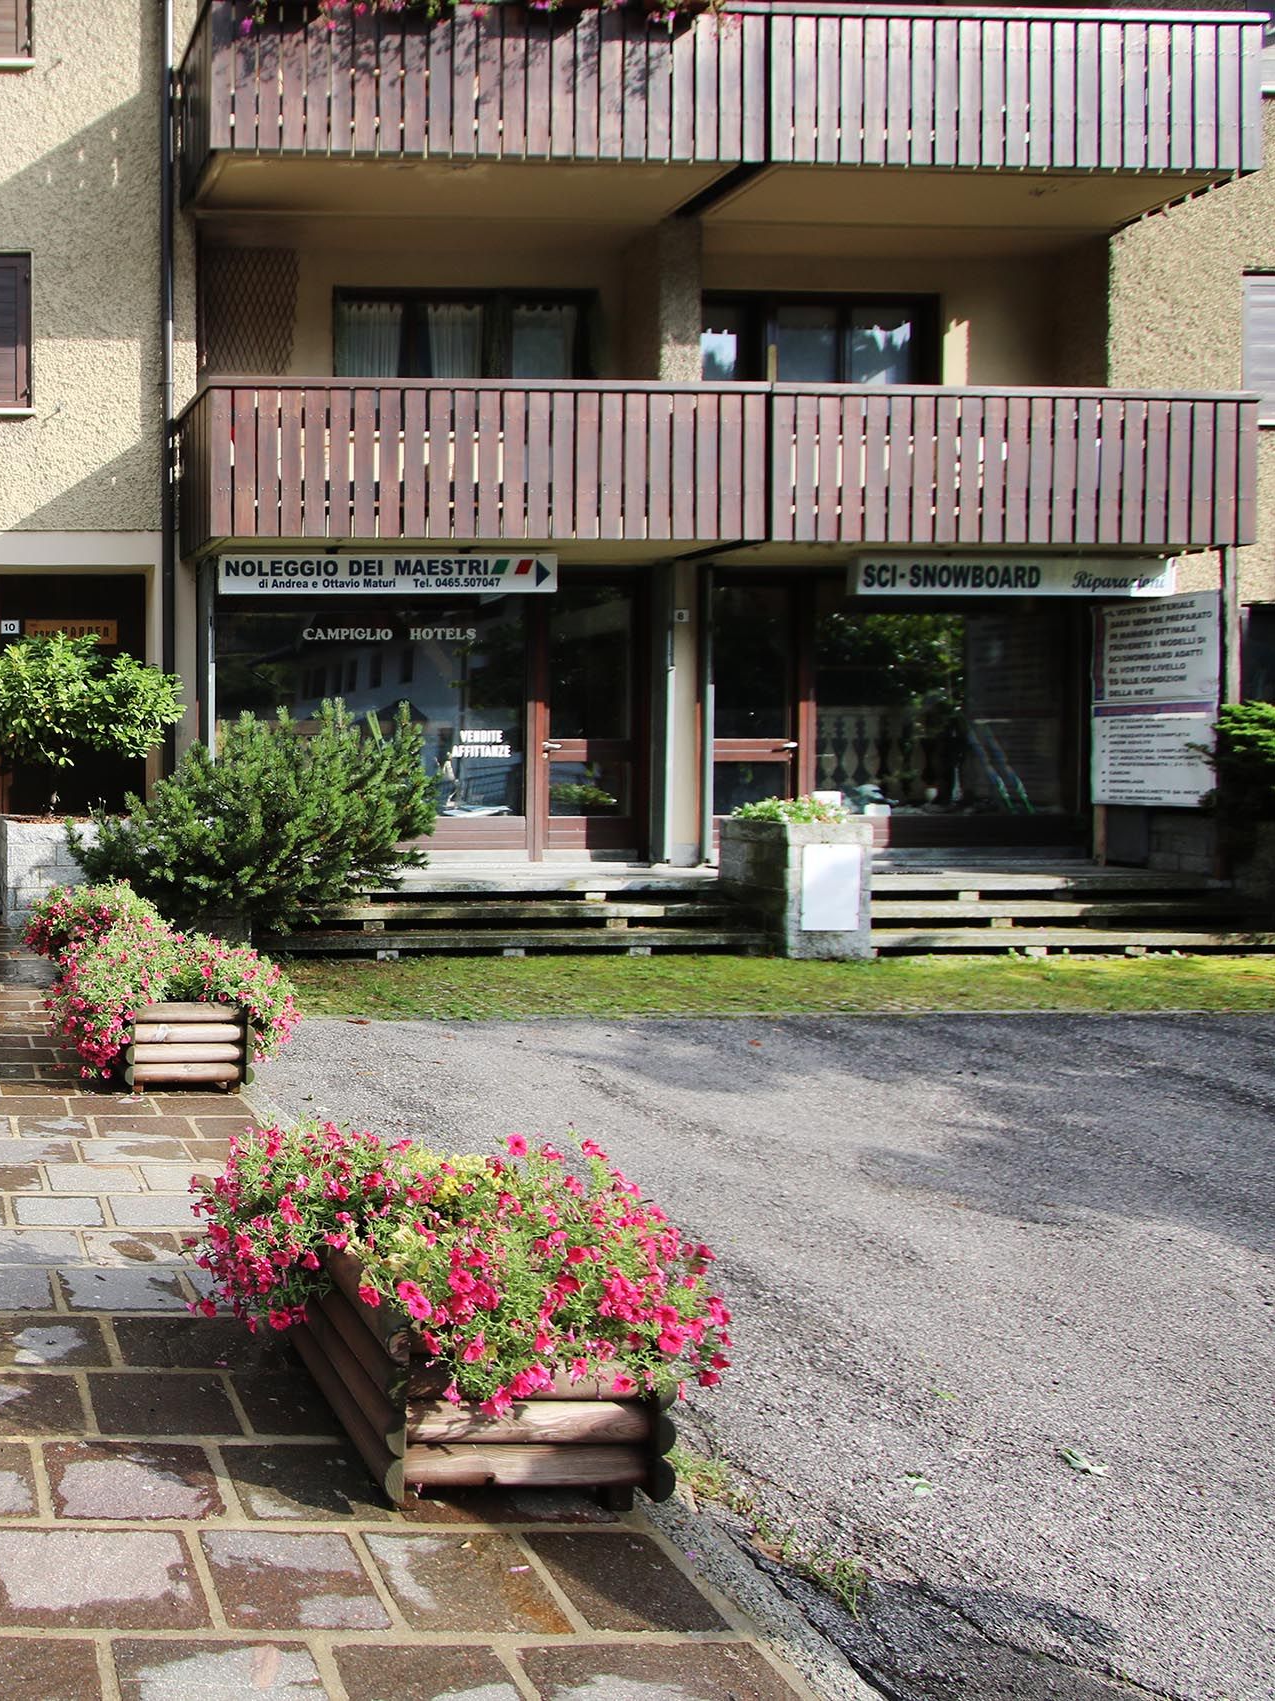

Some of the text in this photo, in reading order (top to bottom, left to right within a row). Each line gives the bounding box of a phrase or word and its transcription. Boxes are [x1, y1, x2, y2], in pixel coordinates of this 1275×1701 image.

[225, 559, 488, 577] NOLEGGIO DEI MAESTRI
[259, 577, 501, 588] di Andrea e Ottavio Maturi Tel. 0465.507047
[1072, 569, 1164, 592] Riparazioni
[1149, 600, 1195, 612] MATERIALE
[677, 612, 684, 620] 8
[1165, 611, 1212, 622] PREPARATO
[5, 623, 15, 632] 10
[303, 628, 477, 641] CAMPIGLIO HOTELS
[1159, 637, 1195, 647] MODELLI
[1153, 662, 1186, 672] LIVELLO
[460, 730, 503, 743] VENDITE
[452, 745, 511, 758] AFFITTANZE
